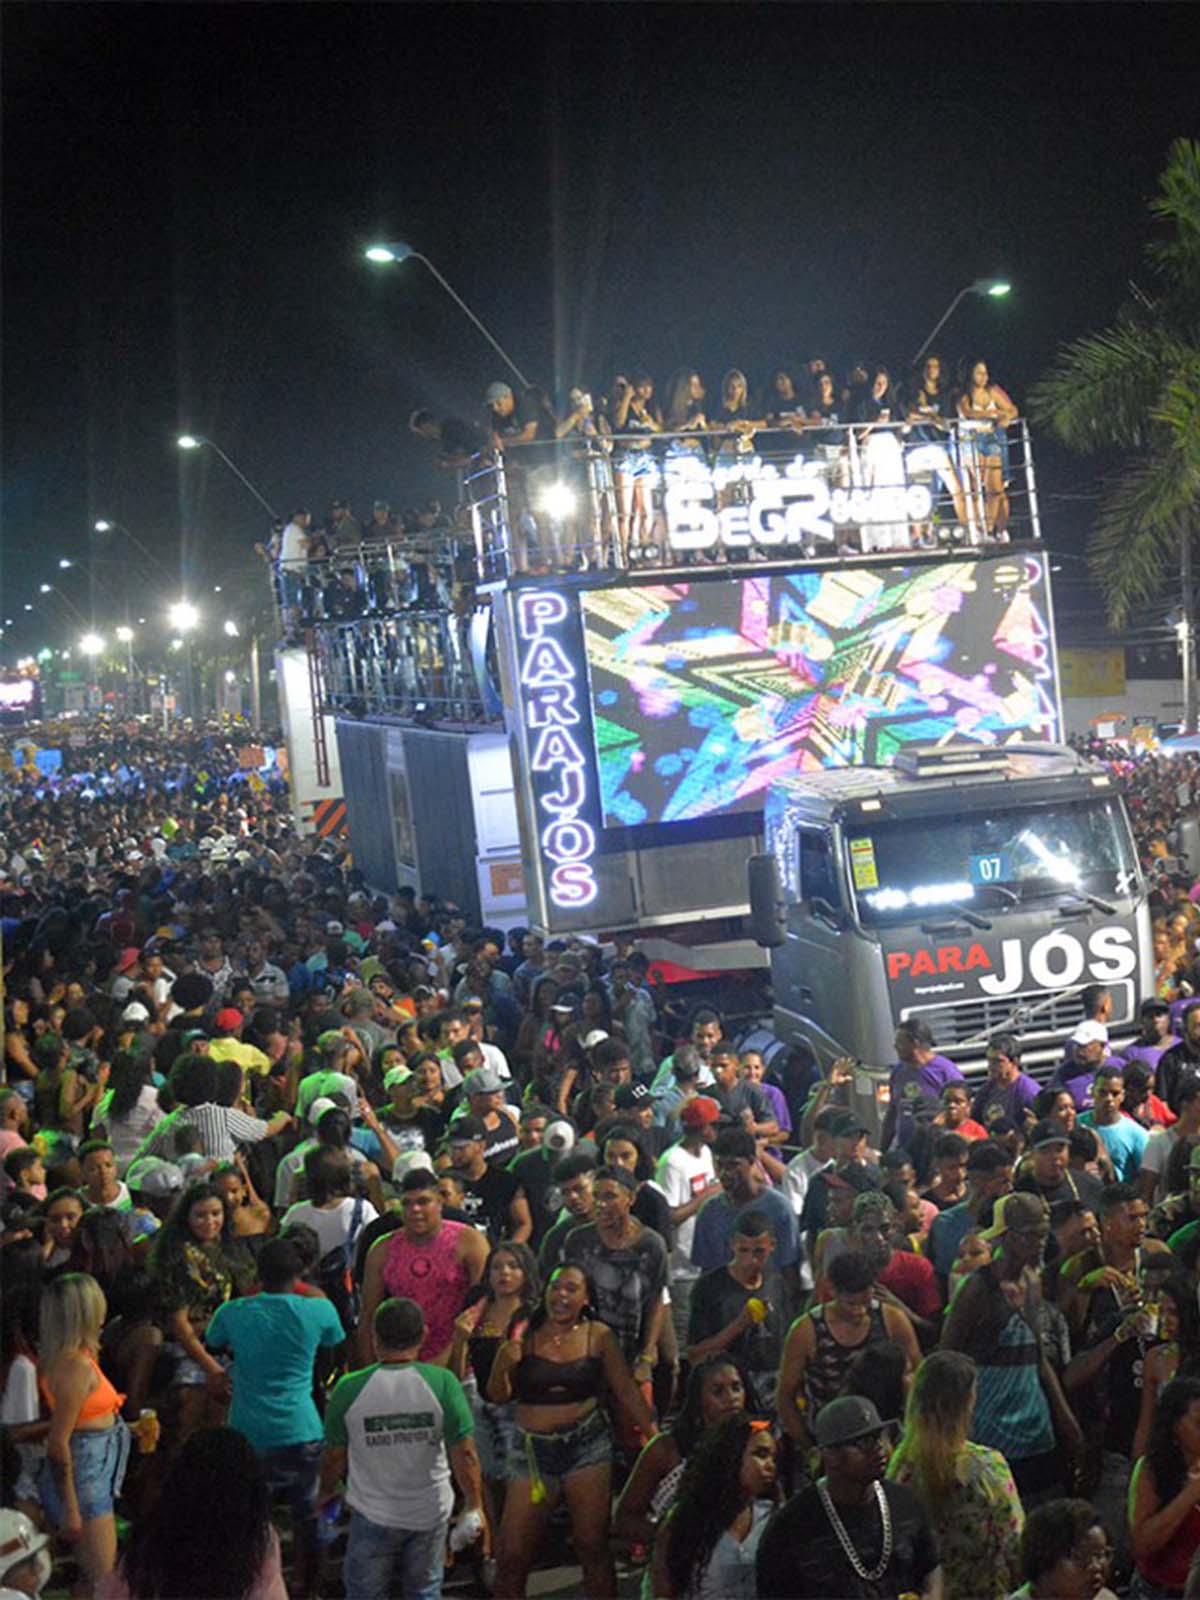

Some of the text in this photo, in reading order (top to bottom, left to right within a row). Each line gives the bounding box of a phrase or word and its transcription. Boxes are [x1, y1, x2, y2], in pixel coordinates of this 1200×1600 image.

[979, 857, 1002, 882] 07
[887, 926, 1138, 995] PARA JÓS
